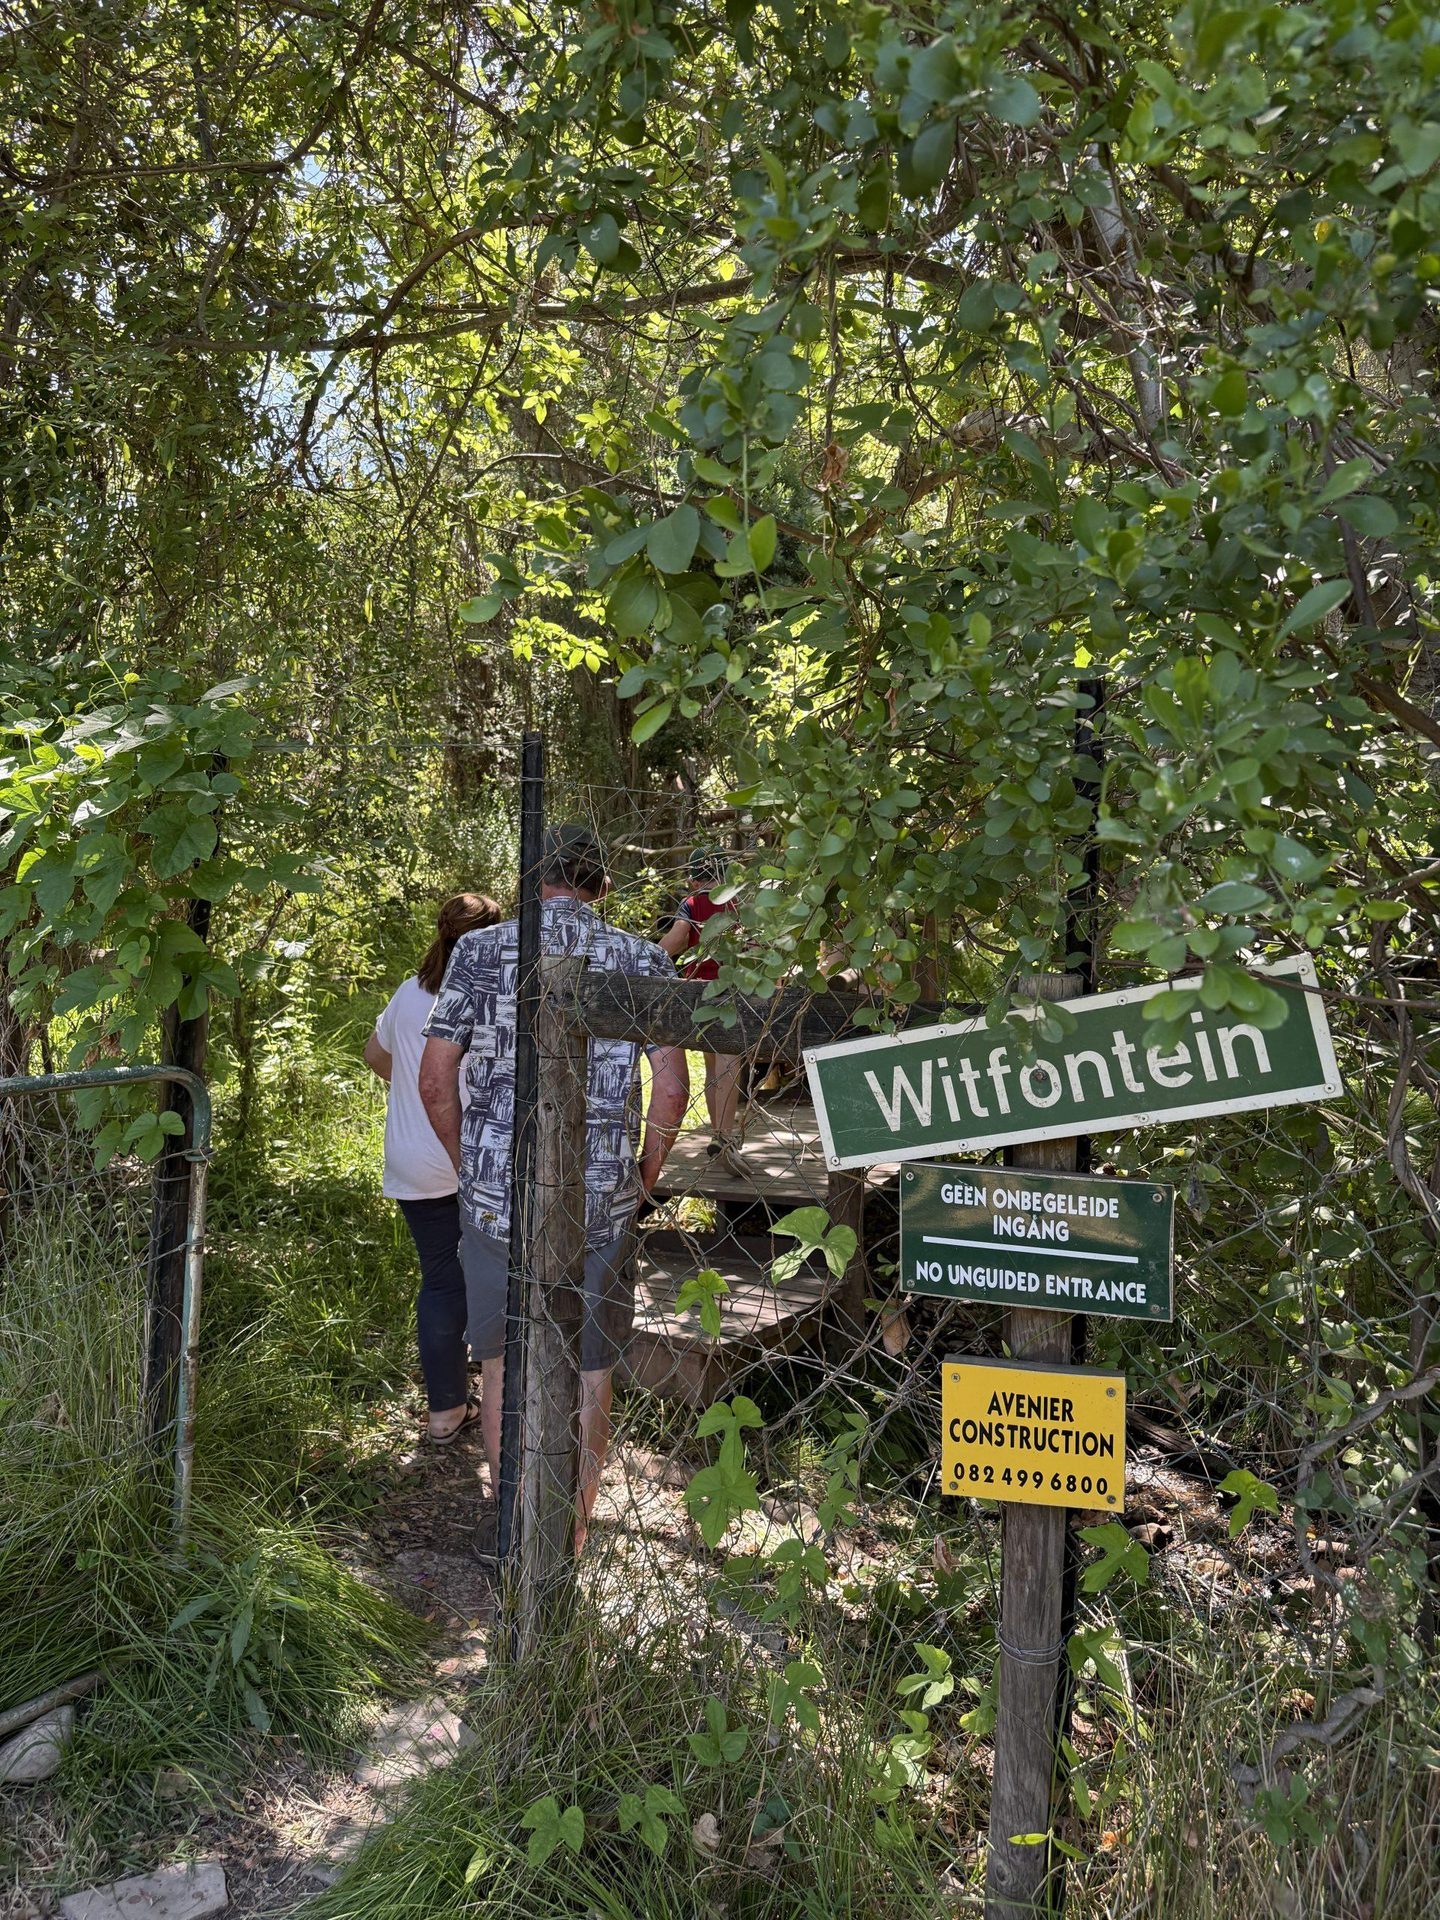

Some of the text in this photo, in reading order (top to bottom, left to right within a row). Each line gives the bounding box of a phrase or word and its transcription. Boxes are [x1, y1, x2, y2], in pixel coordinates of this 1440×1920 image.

[864, 1011, 1272, 1132] Witfontein
[992, 1188, 1120, 1219] ONBEGELEIDE
[916, 1260, 1147, 1304] NO UNGUIDED ENTRANCE
[986, 1391, 1075, 1423] AVENIER
[949, 1418, 1115, 1460] CONSTRUCTION
[953, 1462, 1109, 1496] 082 499 6800
